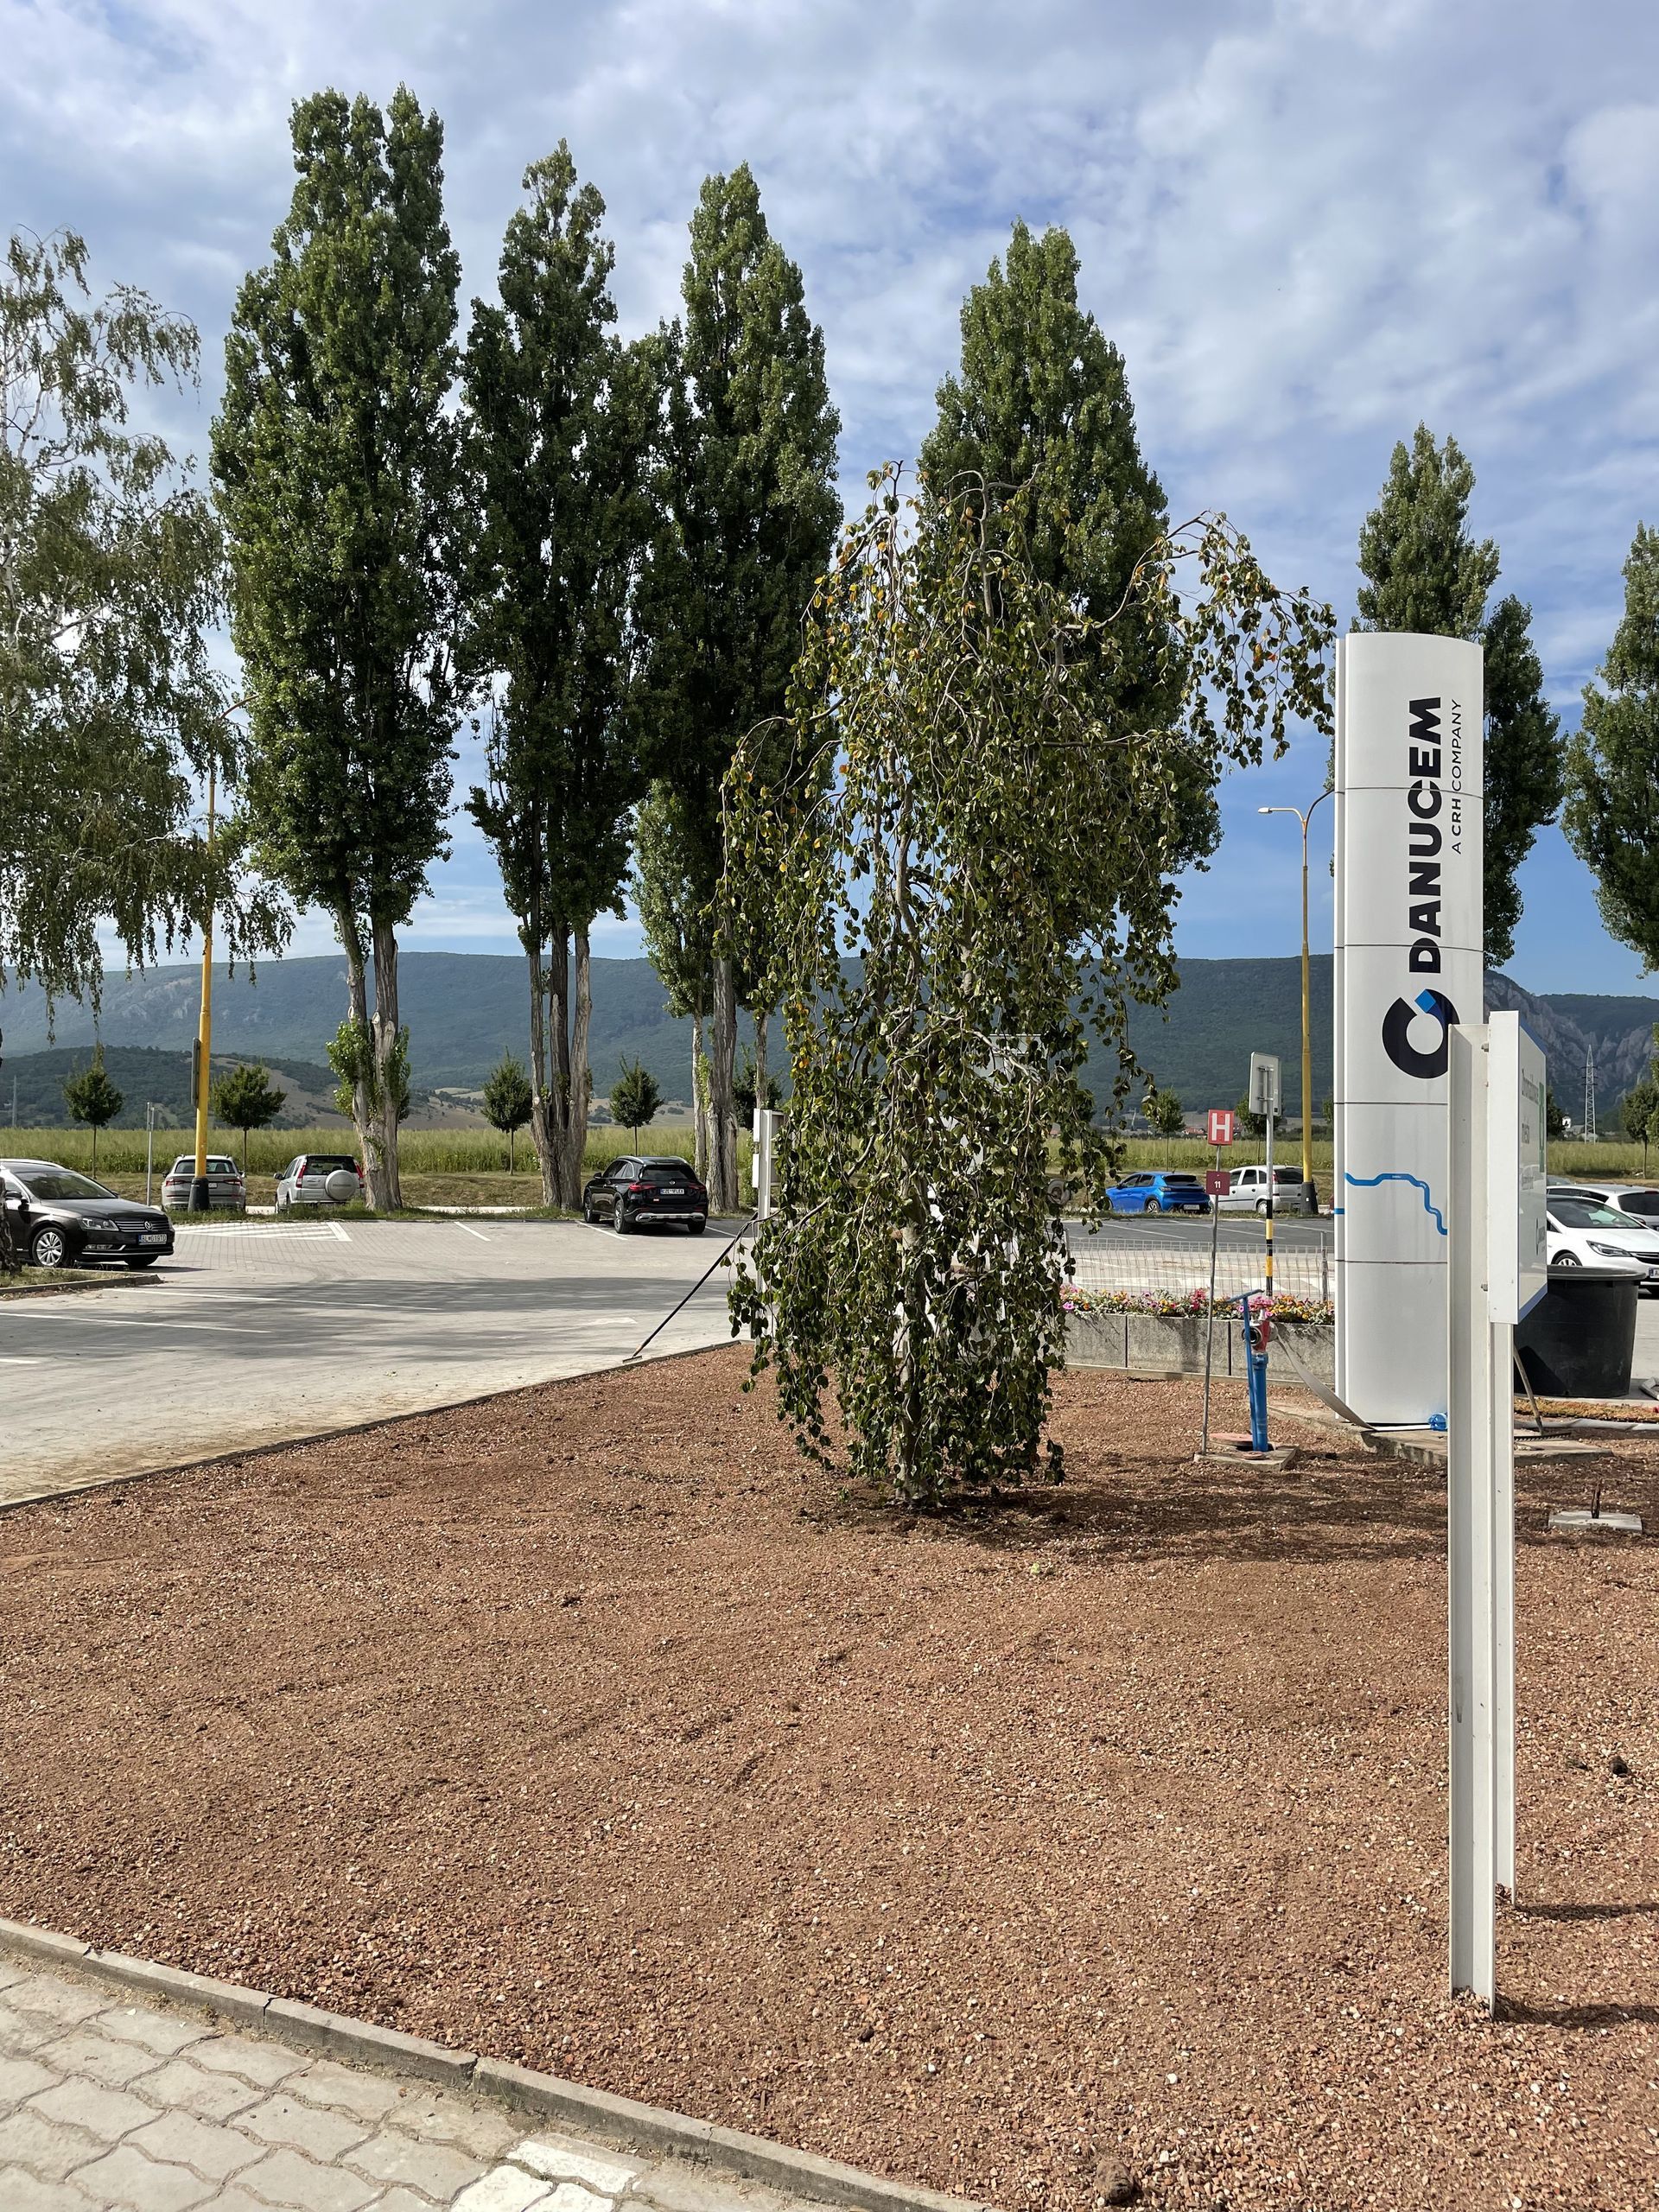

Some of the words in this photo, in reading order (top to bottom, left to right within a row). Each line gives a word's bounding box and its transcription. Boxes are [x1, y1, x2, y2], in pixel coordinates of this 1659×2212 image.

[1452, 699, 1461, 791] COMPANY
[1452, 798, 1461, 836] CRH
[1408, 697, 1442, 973] DANUCEM
[1452, 842, 1461, 855] A
[1211, 1112, 1230, 1141] H
[1214, 1180, 1221, 1189] 11
